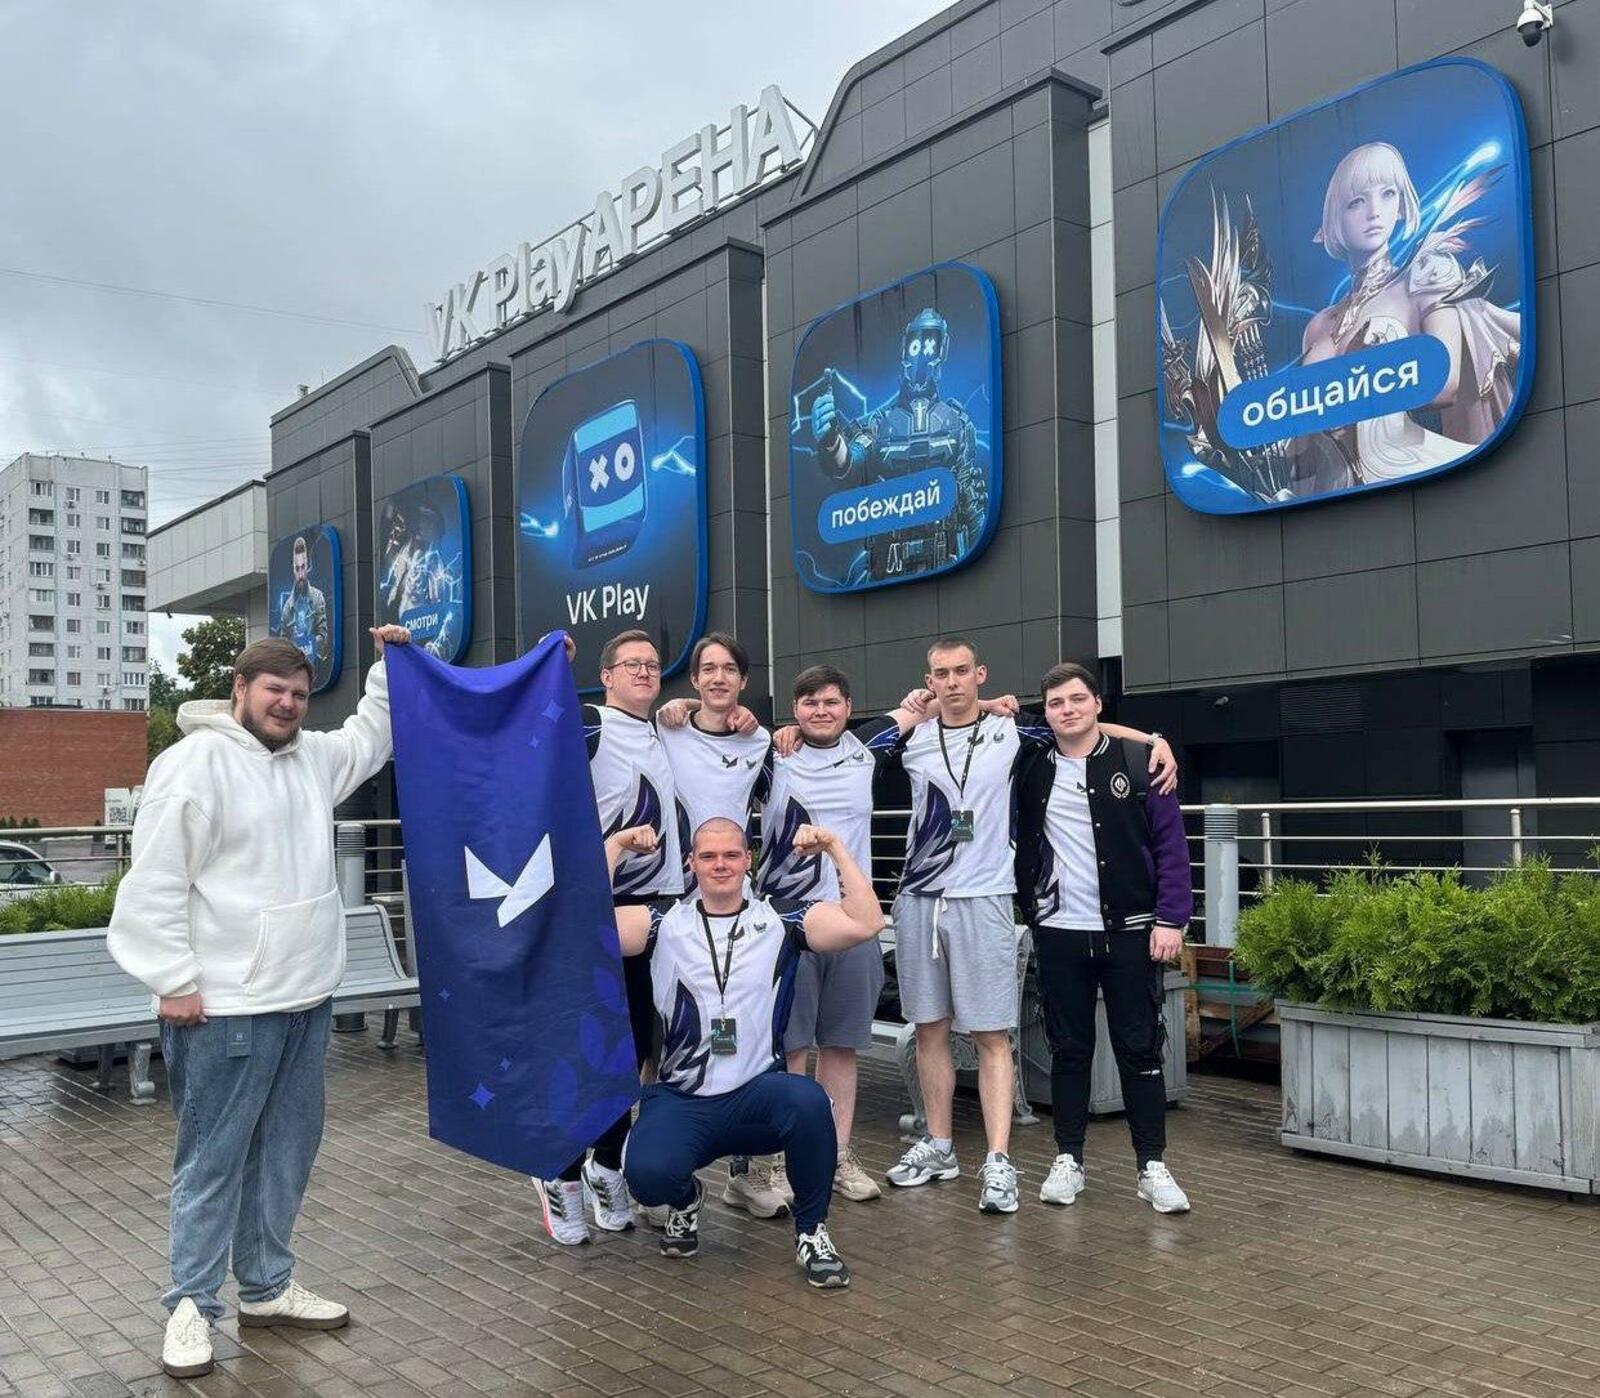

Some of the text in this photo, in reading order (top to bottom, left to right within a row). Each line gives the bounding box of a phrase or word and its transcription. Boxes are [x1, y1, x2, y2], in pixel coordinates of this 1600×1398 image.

[425, 271, 485, 362] VK
[584, 84, 802, 279] АРЕНА
[1241, 359, 1420, 428] общайся
[831, 479, 941, 529] побеждай
[405, 612, 439, 632] смотри
[566, 583, 650, 625] VK Play
